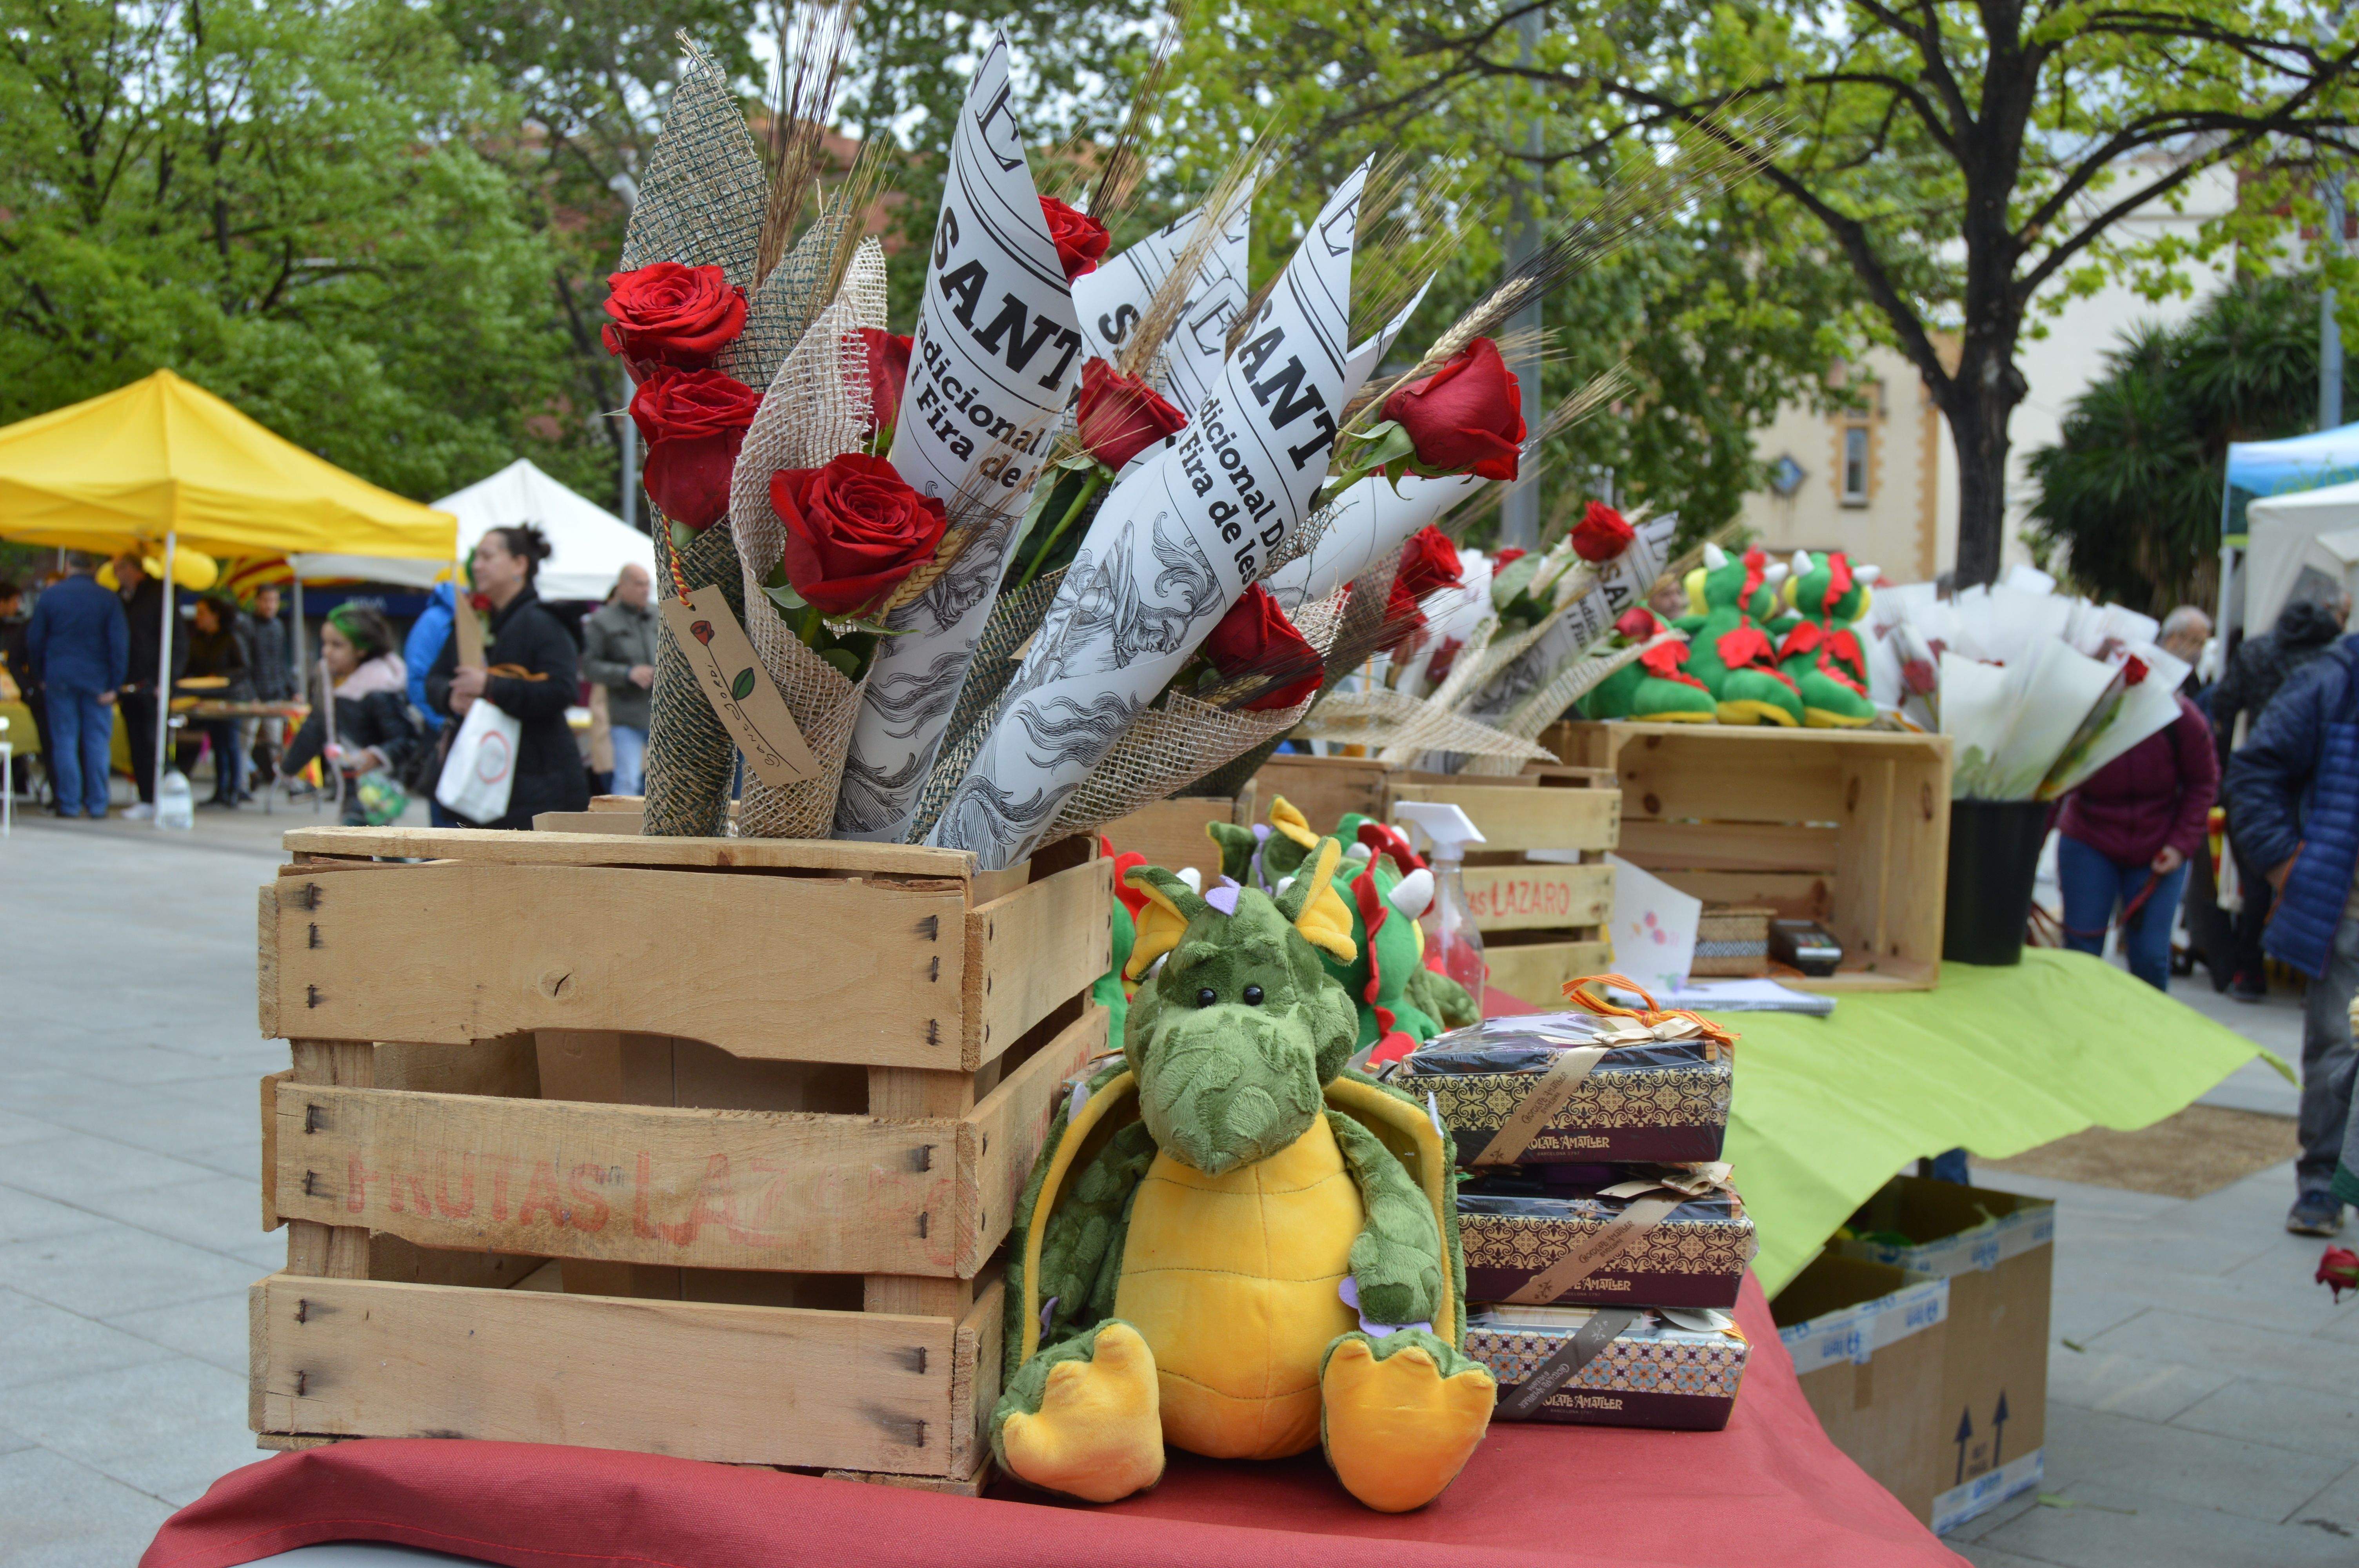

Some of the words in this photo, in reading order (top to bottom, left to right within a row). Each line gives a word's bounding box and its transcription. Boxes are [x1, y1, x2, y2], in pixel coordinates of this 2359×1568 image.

[935, 206, 1082, 392] SANT
[916, 382, 975, 462] Fira
[980, 453, 1021, 488] de
[1178, 430, 1214, 499] Fira
[1208, 500, 1242, 544] de
[1234, 538, 1257, 585] les
[1491, 880, 1571, 918] LAZARO
[1560, 1135, 1610, 1149] AMATLLER
[1582, 1277, 1632, 1291] AMATLLER
[1574, 1394, 1623, 1410] AMATLLER
